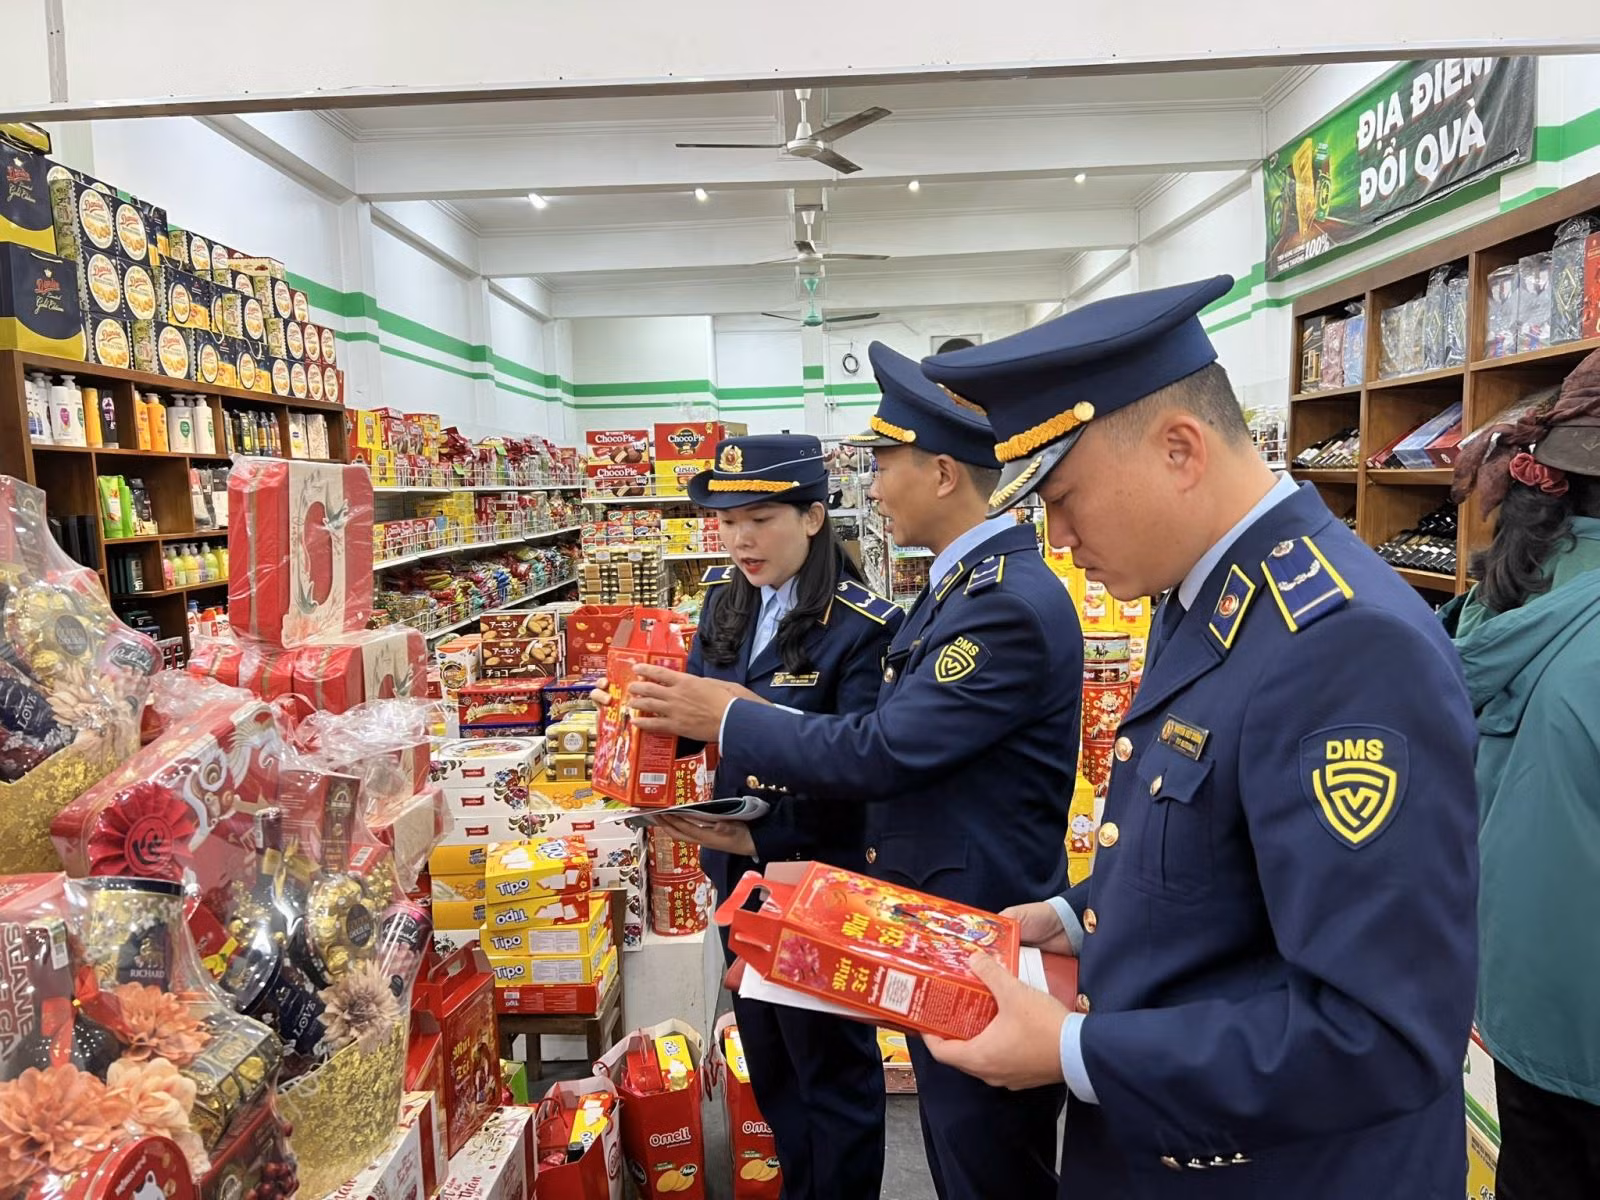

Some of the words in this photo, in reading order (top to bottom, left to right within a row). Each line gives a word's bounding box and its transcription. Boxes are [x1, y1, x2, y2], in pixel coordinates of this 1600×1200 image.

[1357, 92, 1404, 151] ĐỊA
[1359, 138, 1406, 208] ĐỔI
[1414, 98, 1486, 182] QUÀ
[1303, 233, 1330, 260] 100%
[673, 464, 699, 474] Custas
[954, 636, 979, 656] DMS
[485, 669, 509, 677] チョコ
[17, 693, 37, 729] LOVE
[1326, 739, 1384, 761] DMS
[496, 878, 530, 895] Tipo
[495, 909, 528, 925] Tipo
[490, 935, 521, 950] Tipo
[4, 921, 35, 1037] SEAWE
[129, 968, 165, 978] RICHARD
[493, 965, 524, 979] Tipo
[293, 1000, 317, 1037] LOVE
[650, 1127, 691, 1147] Omeli
